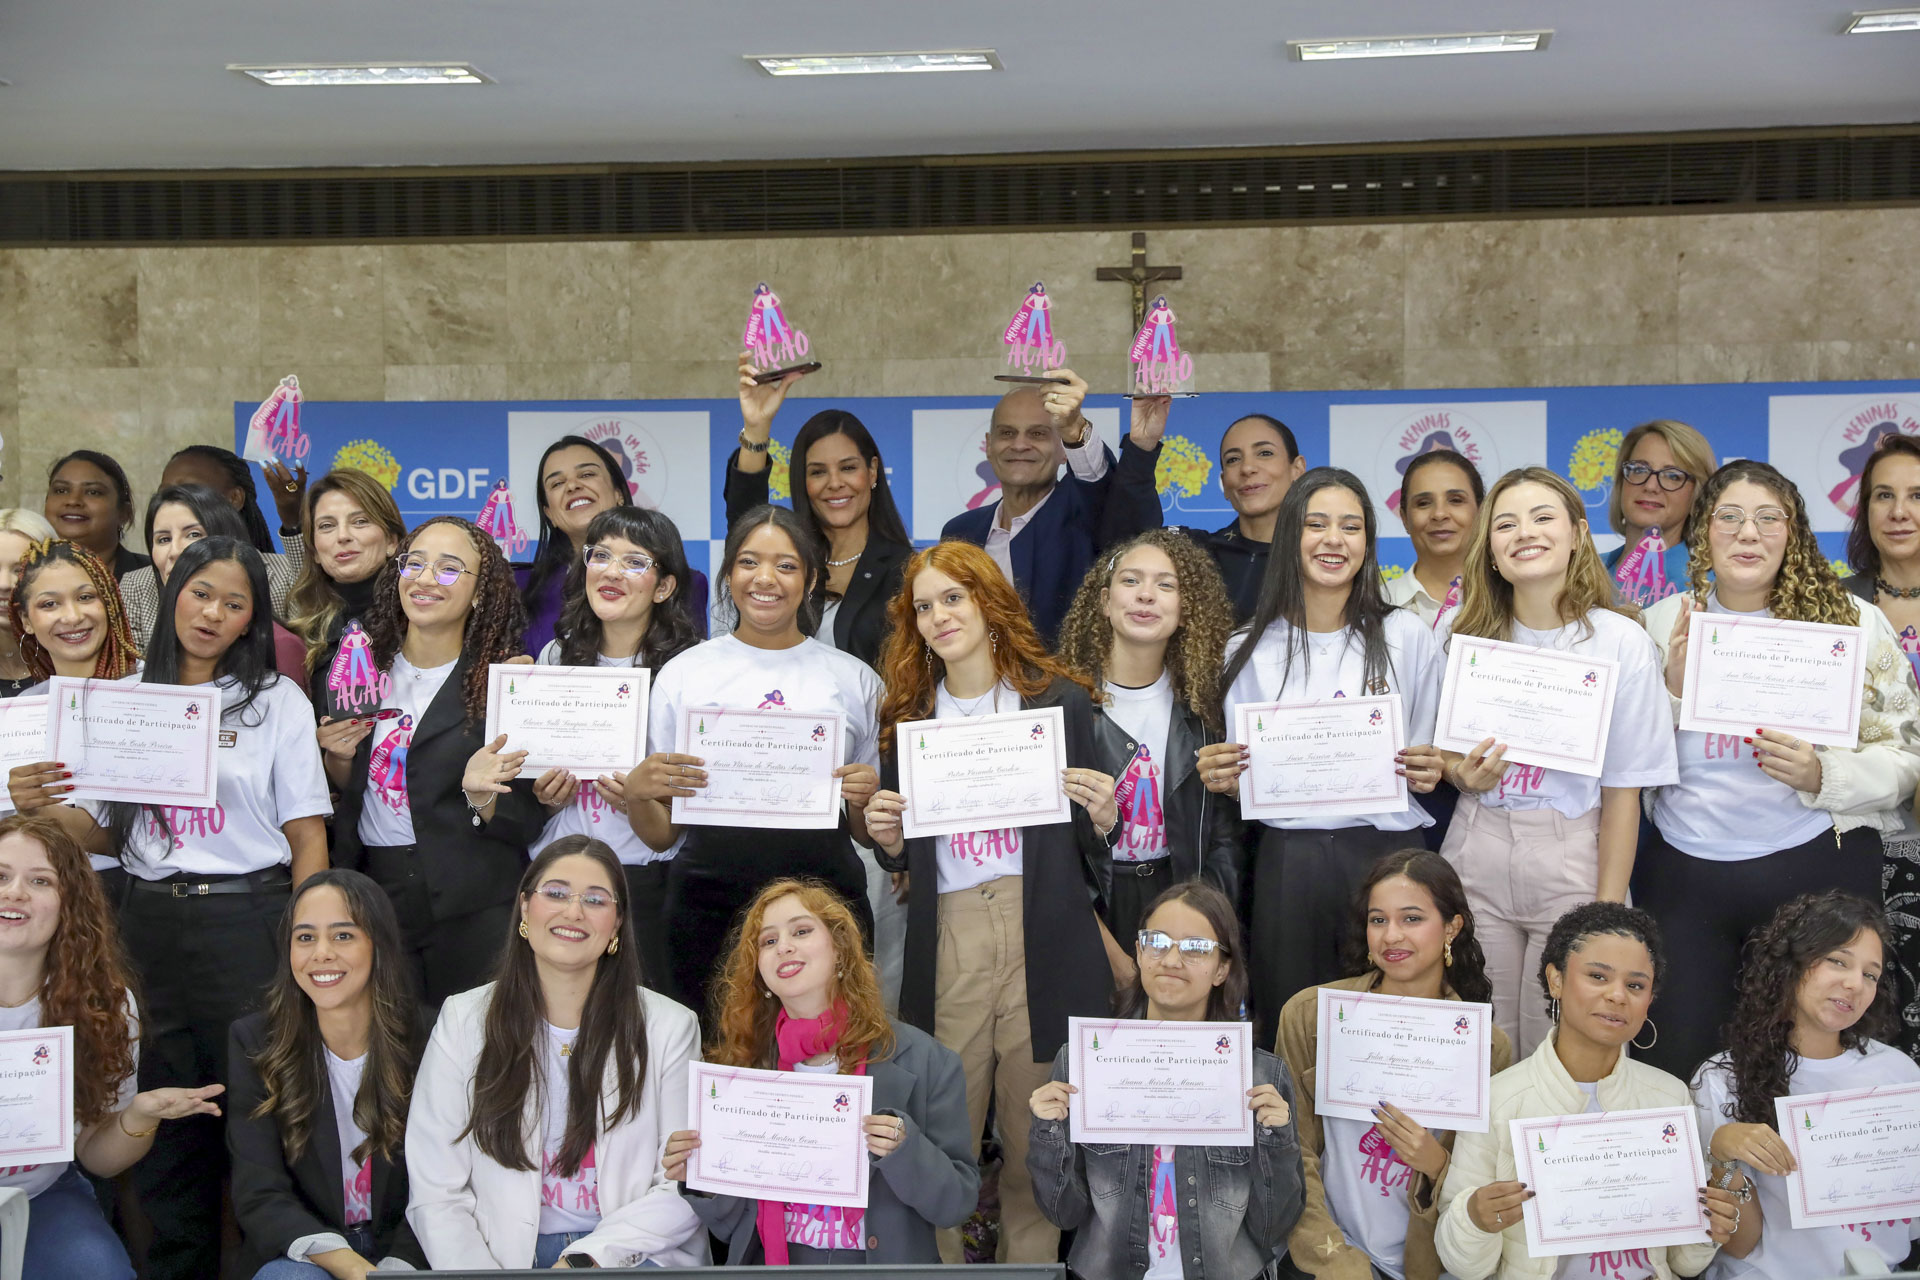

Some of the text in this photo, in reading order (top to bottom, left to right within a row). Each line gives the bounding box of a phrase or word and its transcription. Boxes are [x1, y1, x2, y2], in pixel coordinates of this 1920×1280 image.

[746, 313, 761, 346] MENINAS
[1006, 310, 1029, 342] MENINAS
[754, 325, 808, 371] AÇÃO
[1008, 331, 1066, 376] AÇÃO
[1132, 327, 1153, 360] MENINAS
[254, 400, 279, 428] MENINAS
[1842, 403, 1898, 443] MENINAS
[584, 420, 621, 441] NINAS
[625, 434, 640, 450] EM
[1399, 413, 1451, 450] MENINAS
[1454, 426, 1471, 442] EM
[407, 468, 489, 499] GDF
[477, 506, 494, 530] ENINAS
[1617, 551, 1643, 580] MENINAS
[331, 653, 349, 688] MENINAS
[1713, 649, 1767, 660] Certificado
[1784, 656, 1842, 667] Participação
[335, 667, 392, 715] AÇÃO
[1471, 671, 1593, 697] Certificado de Participação
[575, 701, 627, 709] Participação
[72, 715, 124, 726] Certificado
[140, 720, 196, 730] Participação
[701, 739, 752, 748] Certificado
[768, 743, 823, 752] Participação
[1261, 733, 1311, 743] Certificado
[1327, 730, 1381, 738] Participação
[1705, 732, 1739, 759] EM
[368, 745, 389, 779] ENINAS
[923, 743, 1043, 760] Certificado de Participação
[1341, 1026, 1391, 1039] Certificado
[1407, 1033, 1466, 1046] Participação
[1096, 1055, 1151, 1064] Certificado
[1169, 1057, 1228, 1066] Participação
[713, 1103, 846, 1123] Certificado de Participação
[1811, 1128, 1868, 1142] Certificado
[1544, 1147, 1678, 1166] Certificado de Participação
